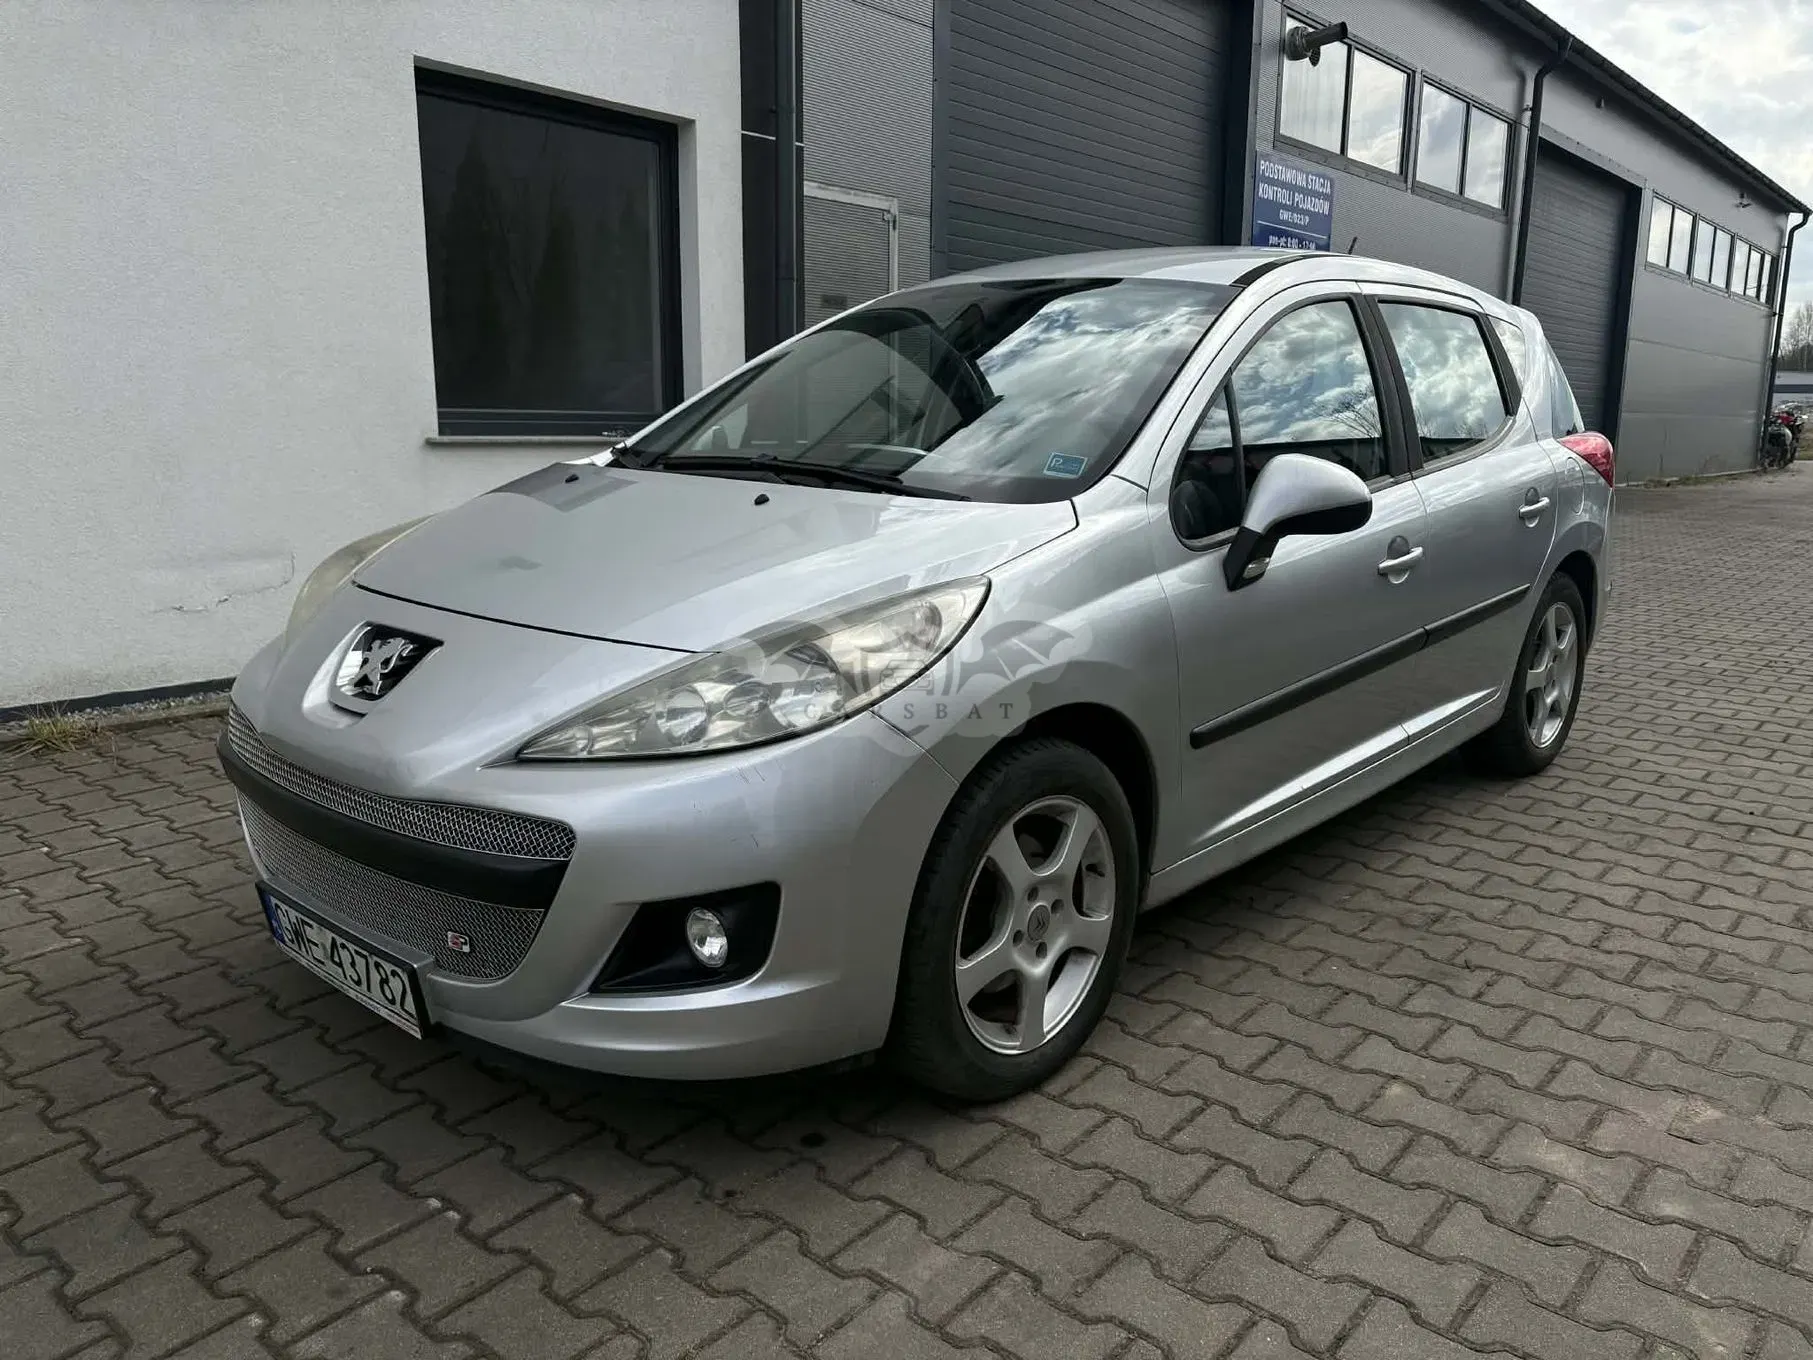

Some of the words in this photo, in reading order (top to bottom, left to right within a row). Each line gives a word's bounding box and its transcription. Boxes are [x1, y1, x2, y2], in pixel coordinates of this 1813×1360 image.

[1260, 160, 1307, 188] PODSTAWOWA
[1308, 173, 1331, 195] STACJA
[1259, 182, 1293, 206] KONTROLI
[1295, 194, 1330, 216] POJAZDÓW
[275, 903, 326, 967] GWE
[330, 935, 417, 1020] 43782
